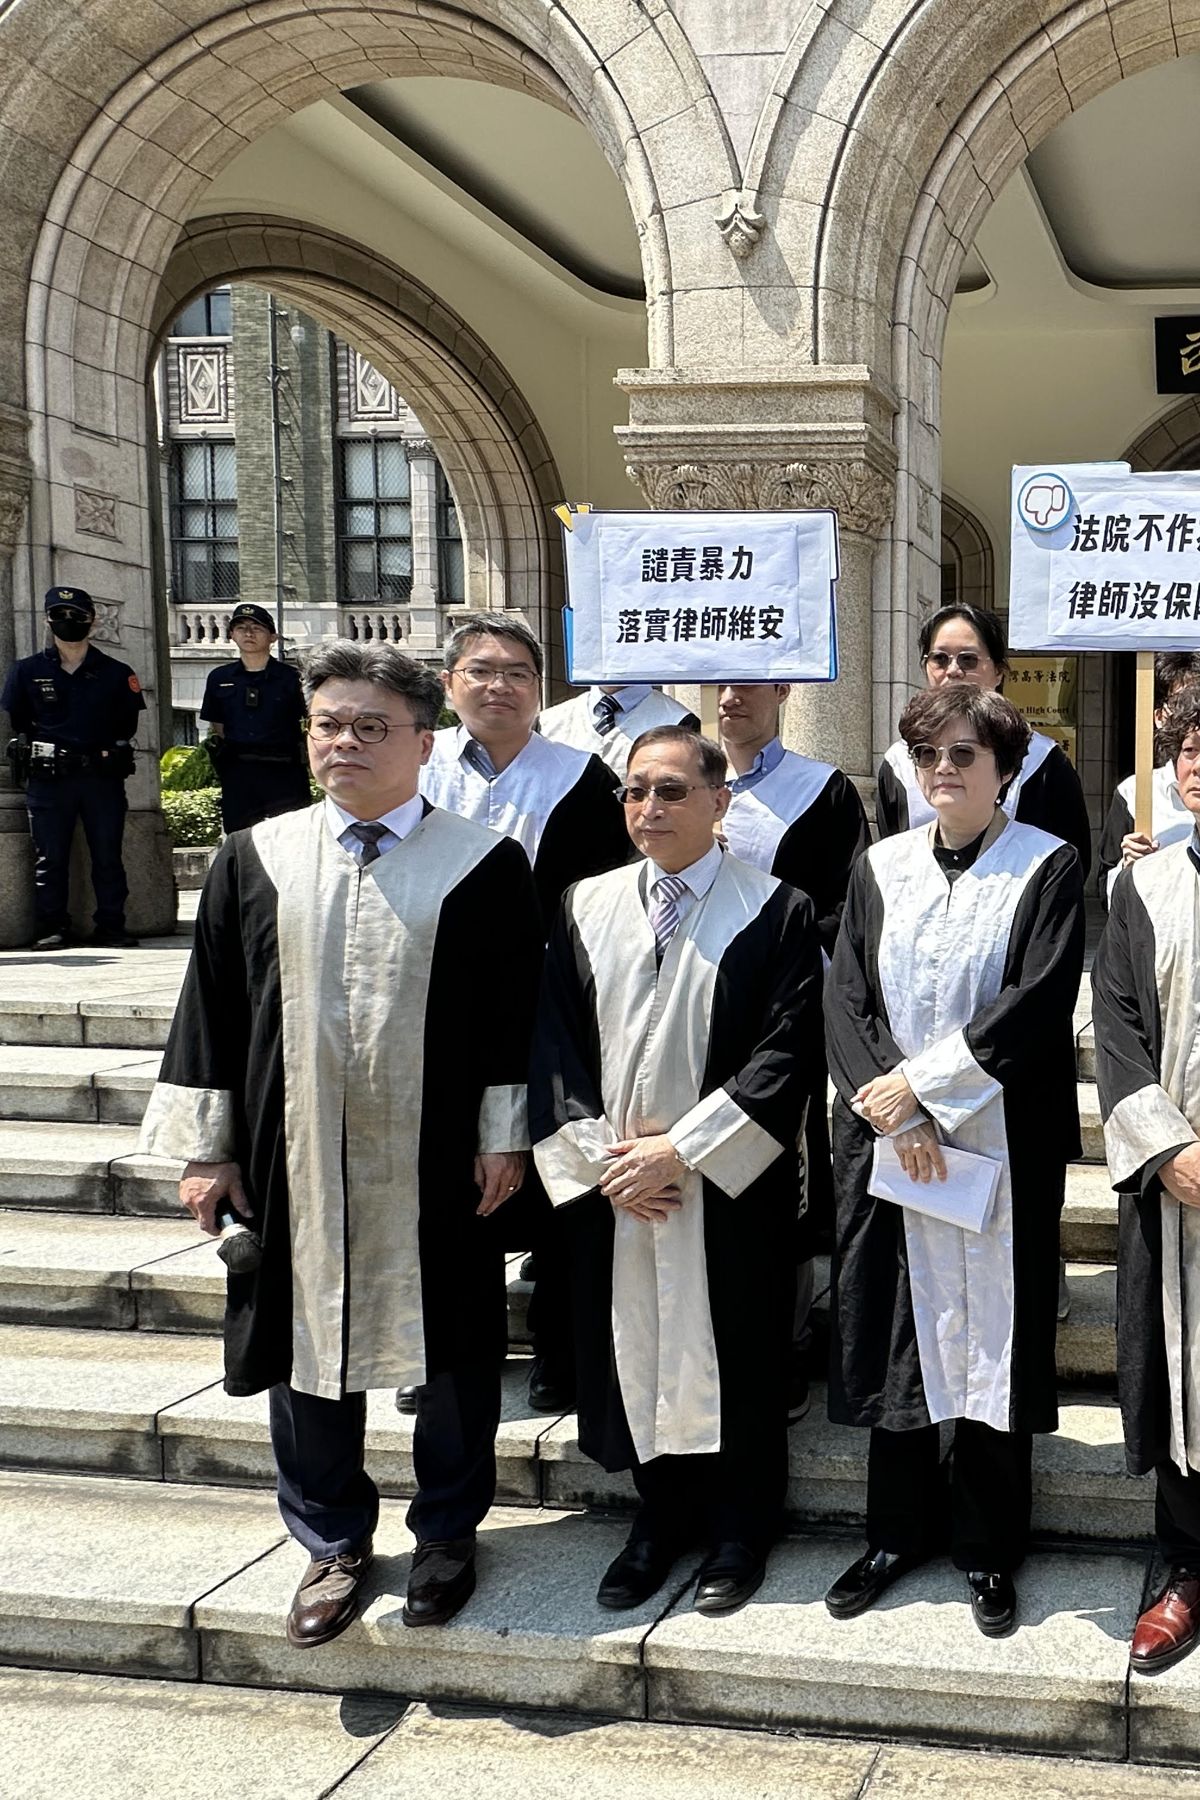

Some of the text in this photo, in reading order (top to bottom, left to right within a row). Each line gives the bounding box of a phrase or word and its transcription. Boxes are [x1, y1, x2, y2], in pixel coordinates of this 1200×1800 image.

[641, 546, 753, 582] 譴責暴力
[616, 605, 784, 643] 落實律師維安
[1026, 706, 1045, 715] High
[1046, 706, 1069, 714] Court
